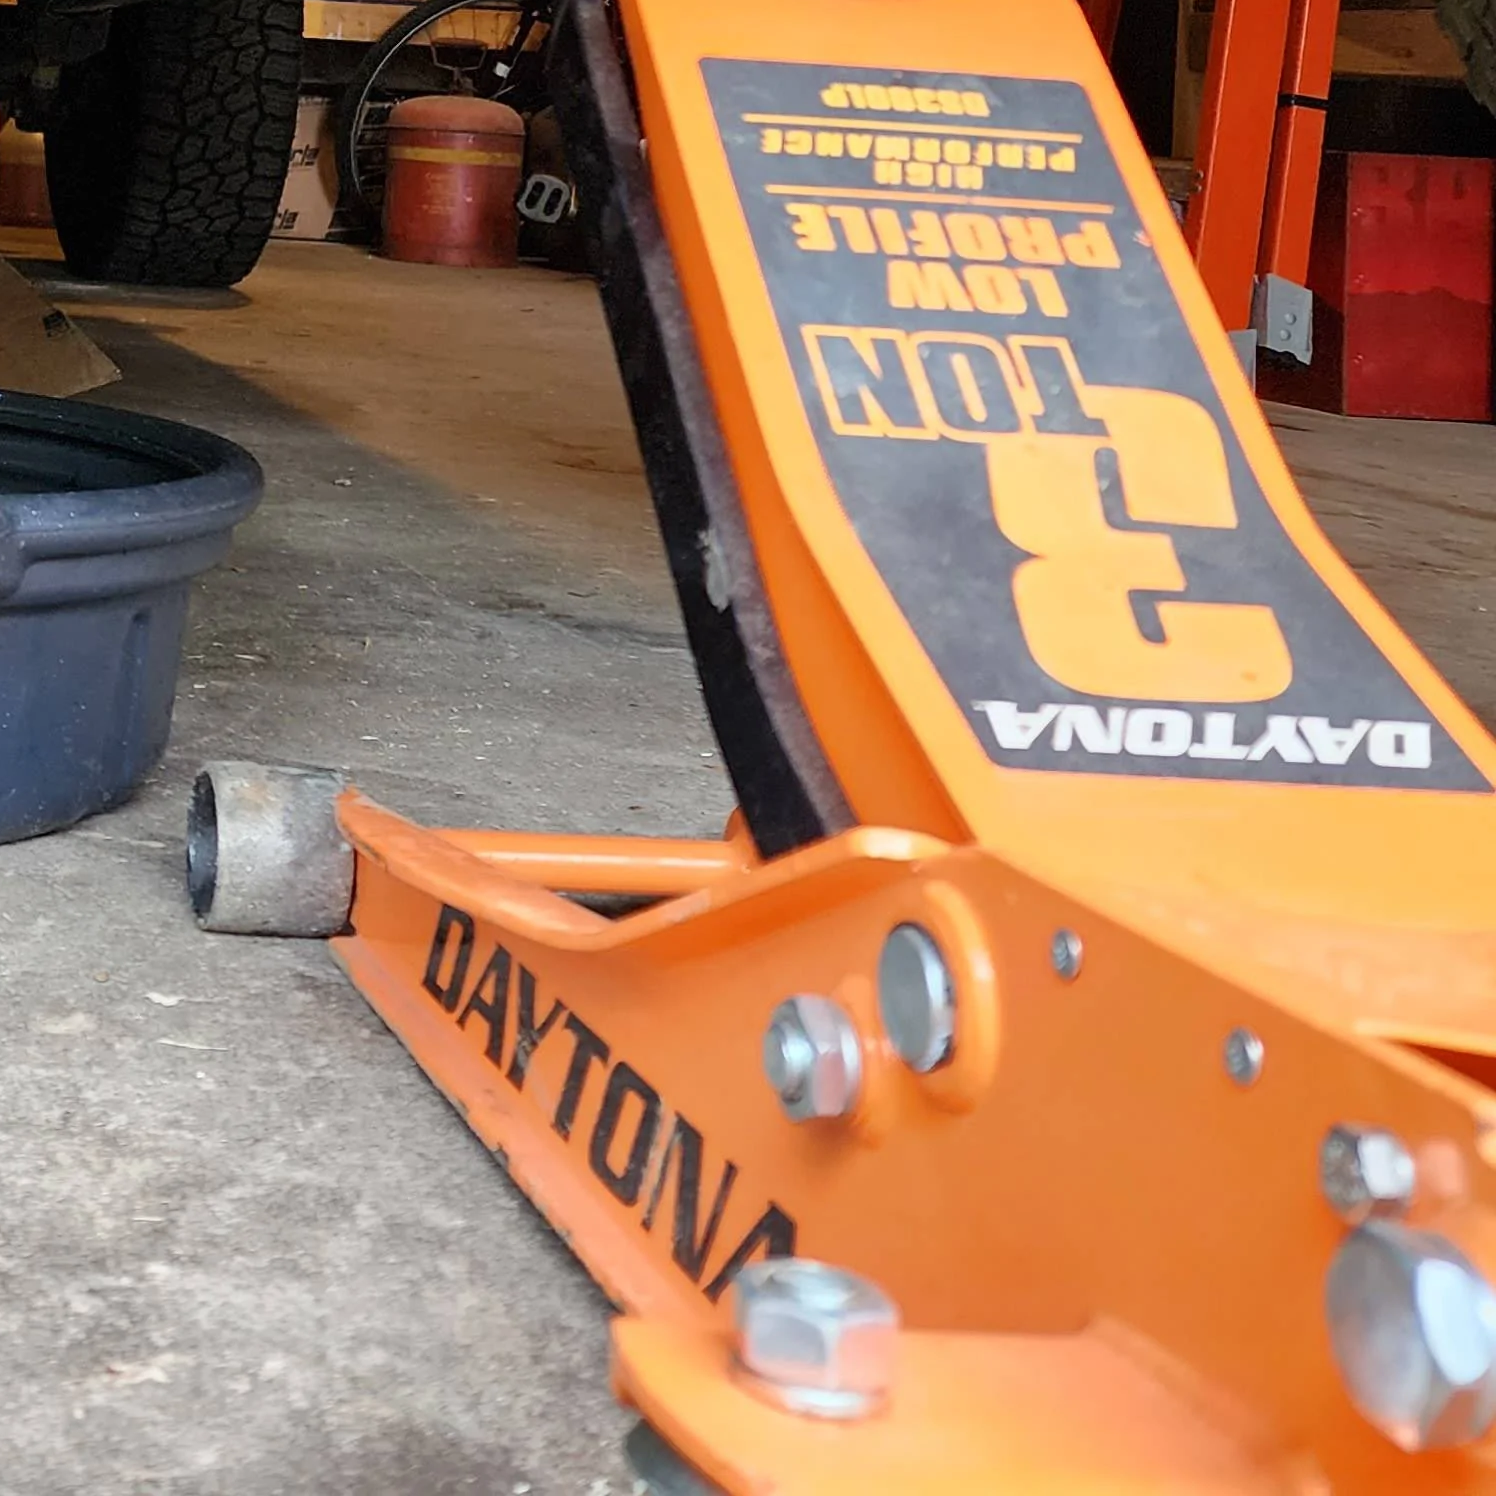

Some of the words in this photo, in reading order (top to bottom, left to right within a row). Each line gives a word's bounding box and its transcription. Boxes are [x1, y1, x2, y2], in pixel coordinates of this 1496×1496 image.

[760, 128, 1076, 172] PERFORMANCE
[873, 159, 984, 190] HIGH
[786, 203, 1121, 268] PROFILE
[887, 261, 1069, 317] LOW
[800, 324, 1110, 442] TON
[986, 385, 1294, 702] 3
[972, 700, 1432, 769] DAYTONA
